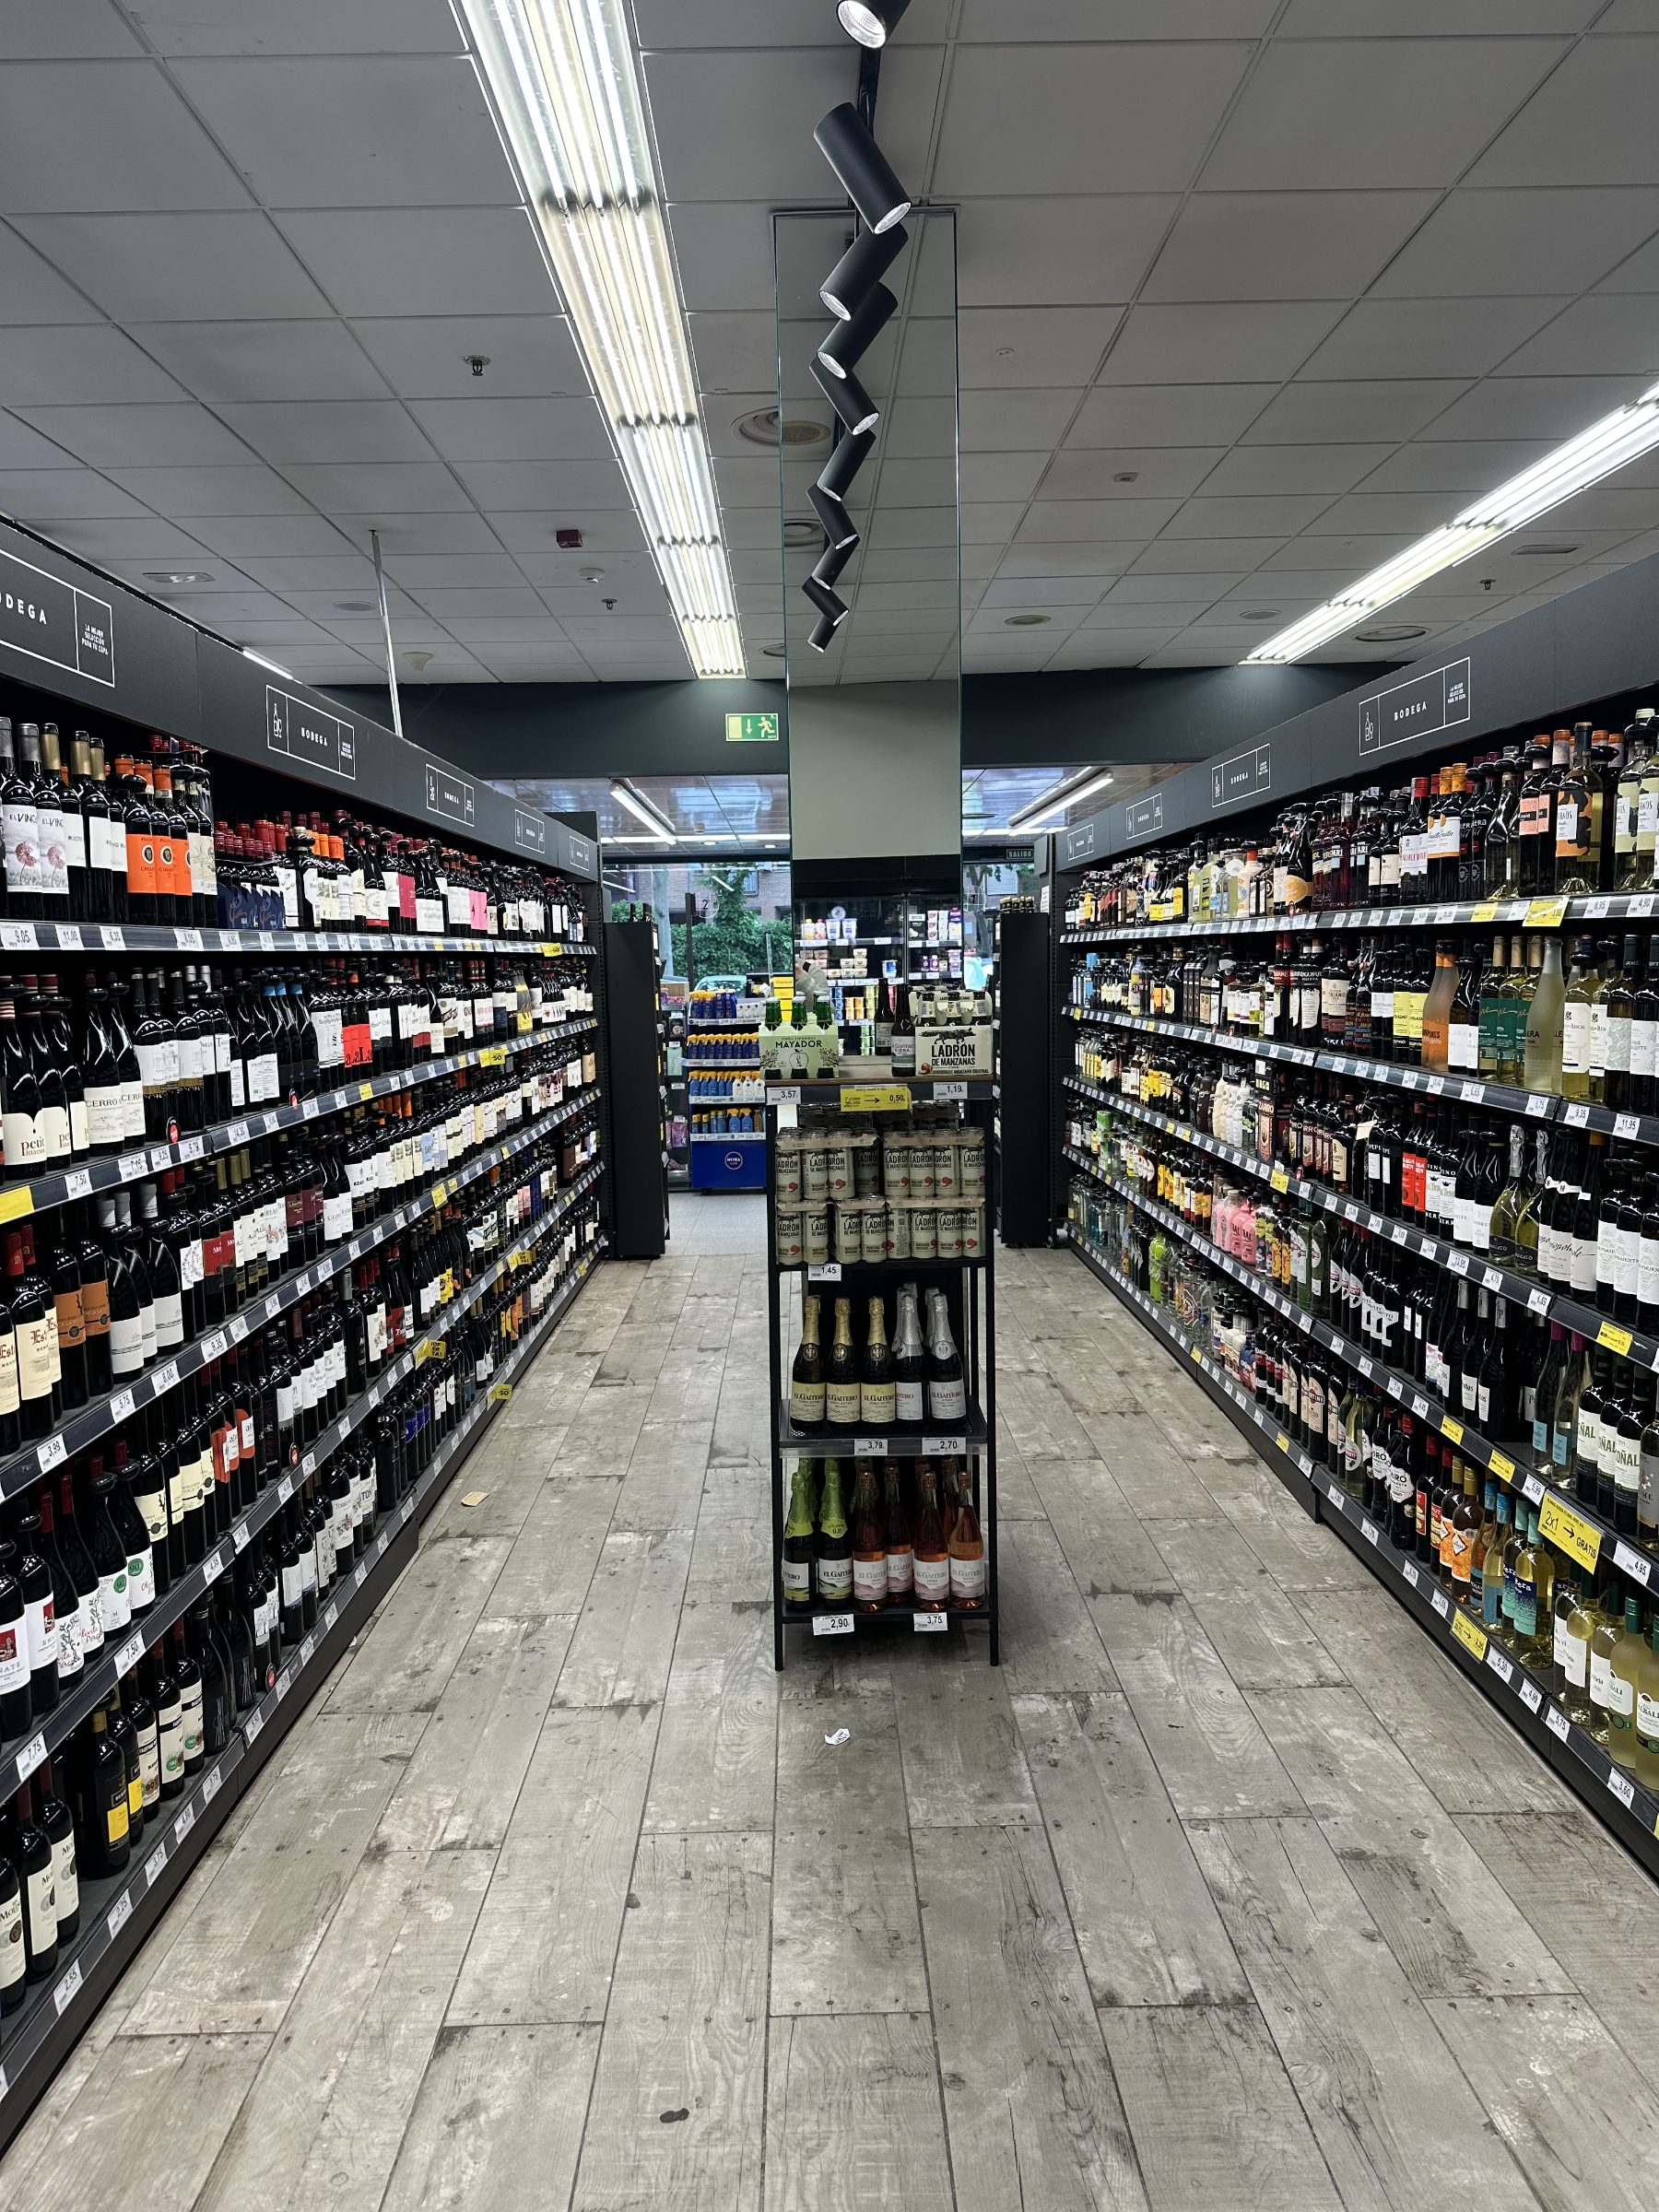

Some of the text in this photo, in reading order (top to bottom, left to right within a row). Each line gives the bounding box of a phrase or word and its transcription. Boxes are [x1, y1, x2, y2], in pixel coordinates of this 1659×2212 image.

[0, 592, 46, 625] DEGA
[1394, 700, 1427, 721] BODEGA
[702, 899, 709, 911] 2
[971, 894, 976, 904] 1
[775, 1040, 822, 1049] MAYADOR
[931, 1042, 976, 1058] LADRÓN
[931, 1057, 976, 1066] DE MANZANAS
[781, 1090, 796, 1099] 3,57
[947, 1085, 962, 1094] 1,19
[86, 1099, 118, 1108] CERRO
[889, 1094, 904, 1103] 0,50
[1621, 1118, 1636, 1130] 11,95
[820, 1266, 837, 1276] 1,45
[47, 1441, 61, 1457] 3,99
[868, 1441, 883, 1450] 3,79
[939, 1441, 958, 1450] 2,70
[1545, 1511, 1559, 1531] 2x1
[1576, 1536, 1596, 1559] GRATIS
[1634, 1560, 1647, 1576] 4,95
[831, 1618, 848, 1629] 2,90
[927, 1616, 942, 1625] 3,75
[125, 1640, 139, 1660] 7,50
[1555, 1715, 1566, 1731] 5,75
[28, 1739, 41, 1761] 7,75
[1618, 1781, 1631, 1797] 3,60
[65, 1969, 77, 1992] 2,55
